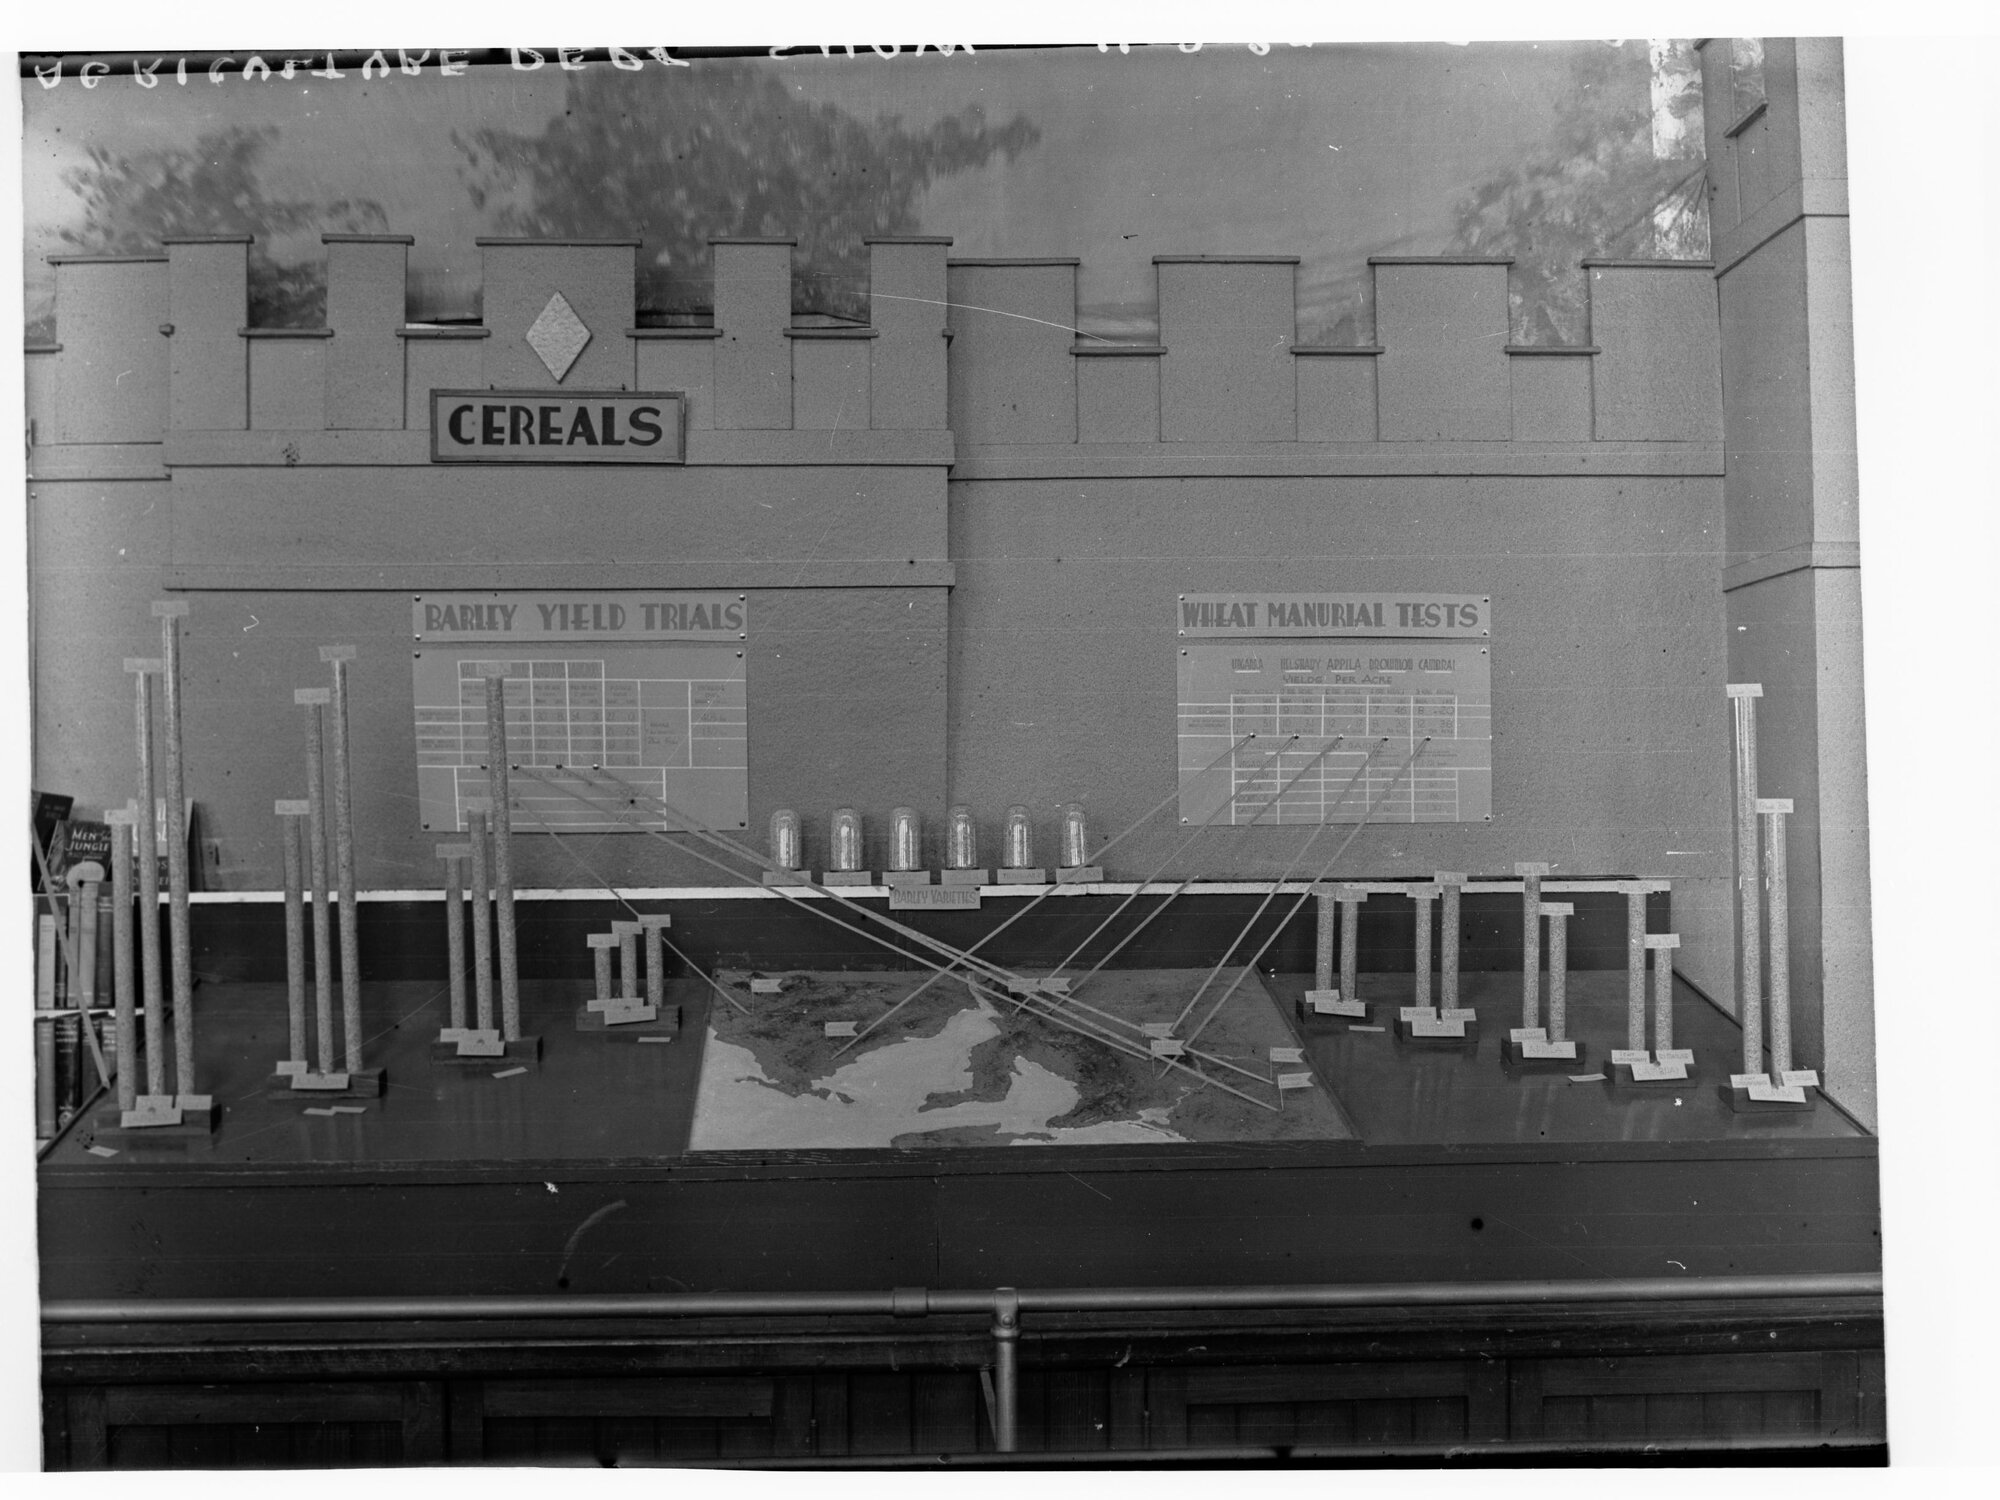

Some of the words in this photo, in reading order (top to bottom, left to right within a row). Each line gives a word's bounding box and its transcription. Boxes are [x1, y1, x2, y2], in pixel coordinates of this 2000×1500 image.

[448, 404, 663, 447] CEREALS
[424, 603, 518, 632] BARLEY
[536, 602, 626, 631] YIELD
[639, 602, 744, 631] TRIALS
[1182, 602, 1258, 628] WHEAT
[1267, 602, 1386, 628] MANURIAL
[1395, 602, 1479, 628] TESTS
[1326, 658, 1362, 671] APPILA
[1283, 675, 1323, 684] YIELDS
[1335, 675, 1356, 684] PER
[1361, 675, 1393, 684] ACRE
[71, 827, 96, 841] MEN
[65, 841, 110, 852] JUNGLE
[893, 889, 928, 904] BARLEY
[931, 889, 977, 904] VARIETIES
